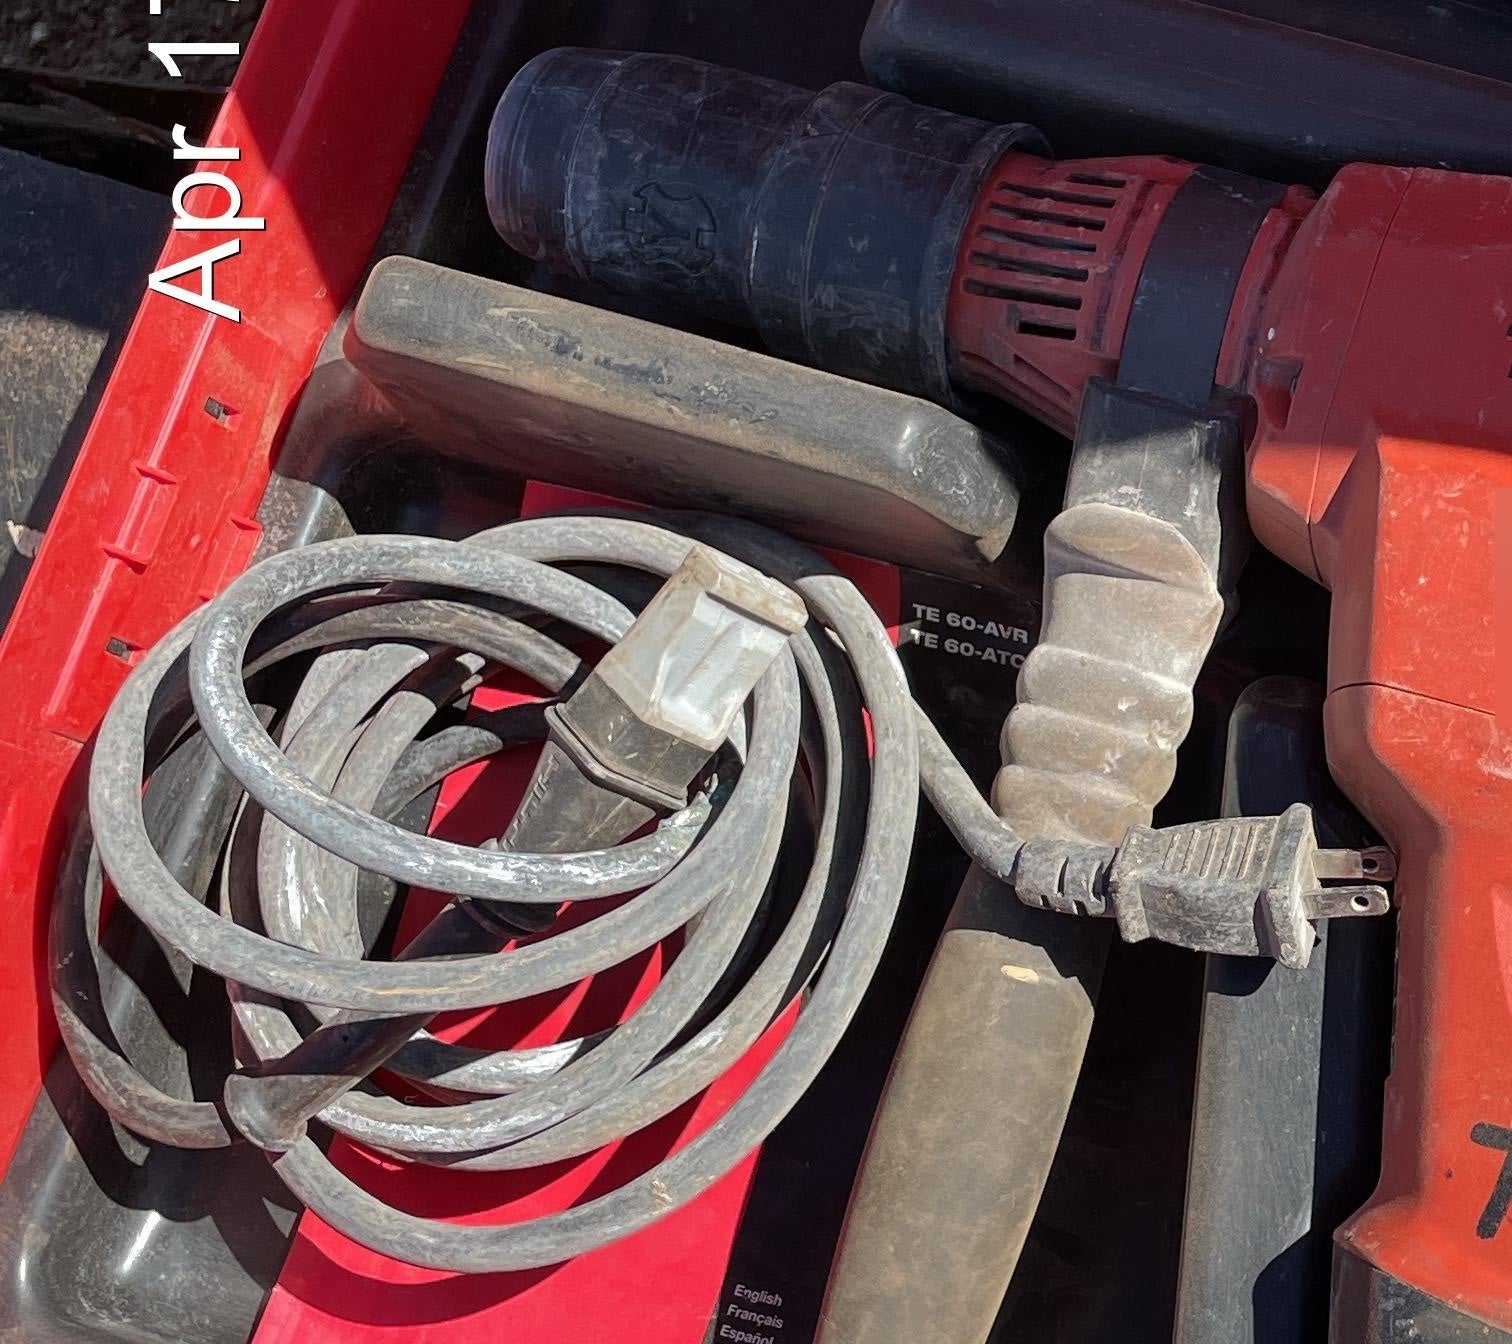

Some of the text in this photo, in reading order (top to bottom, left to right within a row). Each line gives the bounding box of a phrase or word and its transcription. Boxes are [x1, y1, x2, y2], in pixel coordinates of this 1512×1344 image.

[912, 603, 1029, 644] TE 60-AVR
[910, 628, 938, 650] TE
[733, 1283, 783, 1307] English
[726, 1303, 784, 1329] Français
